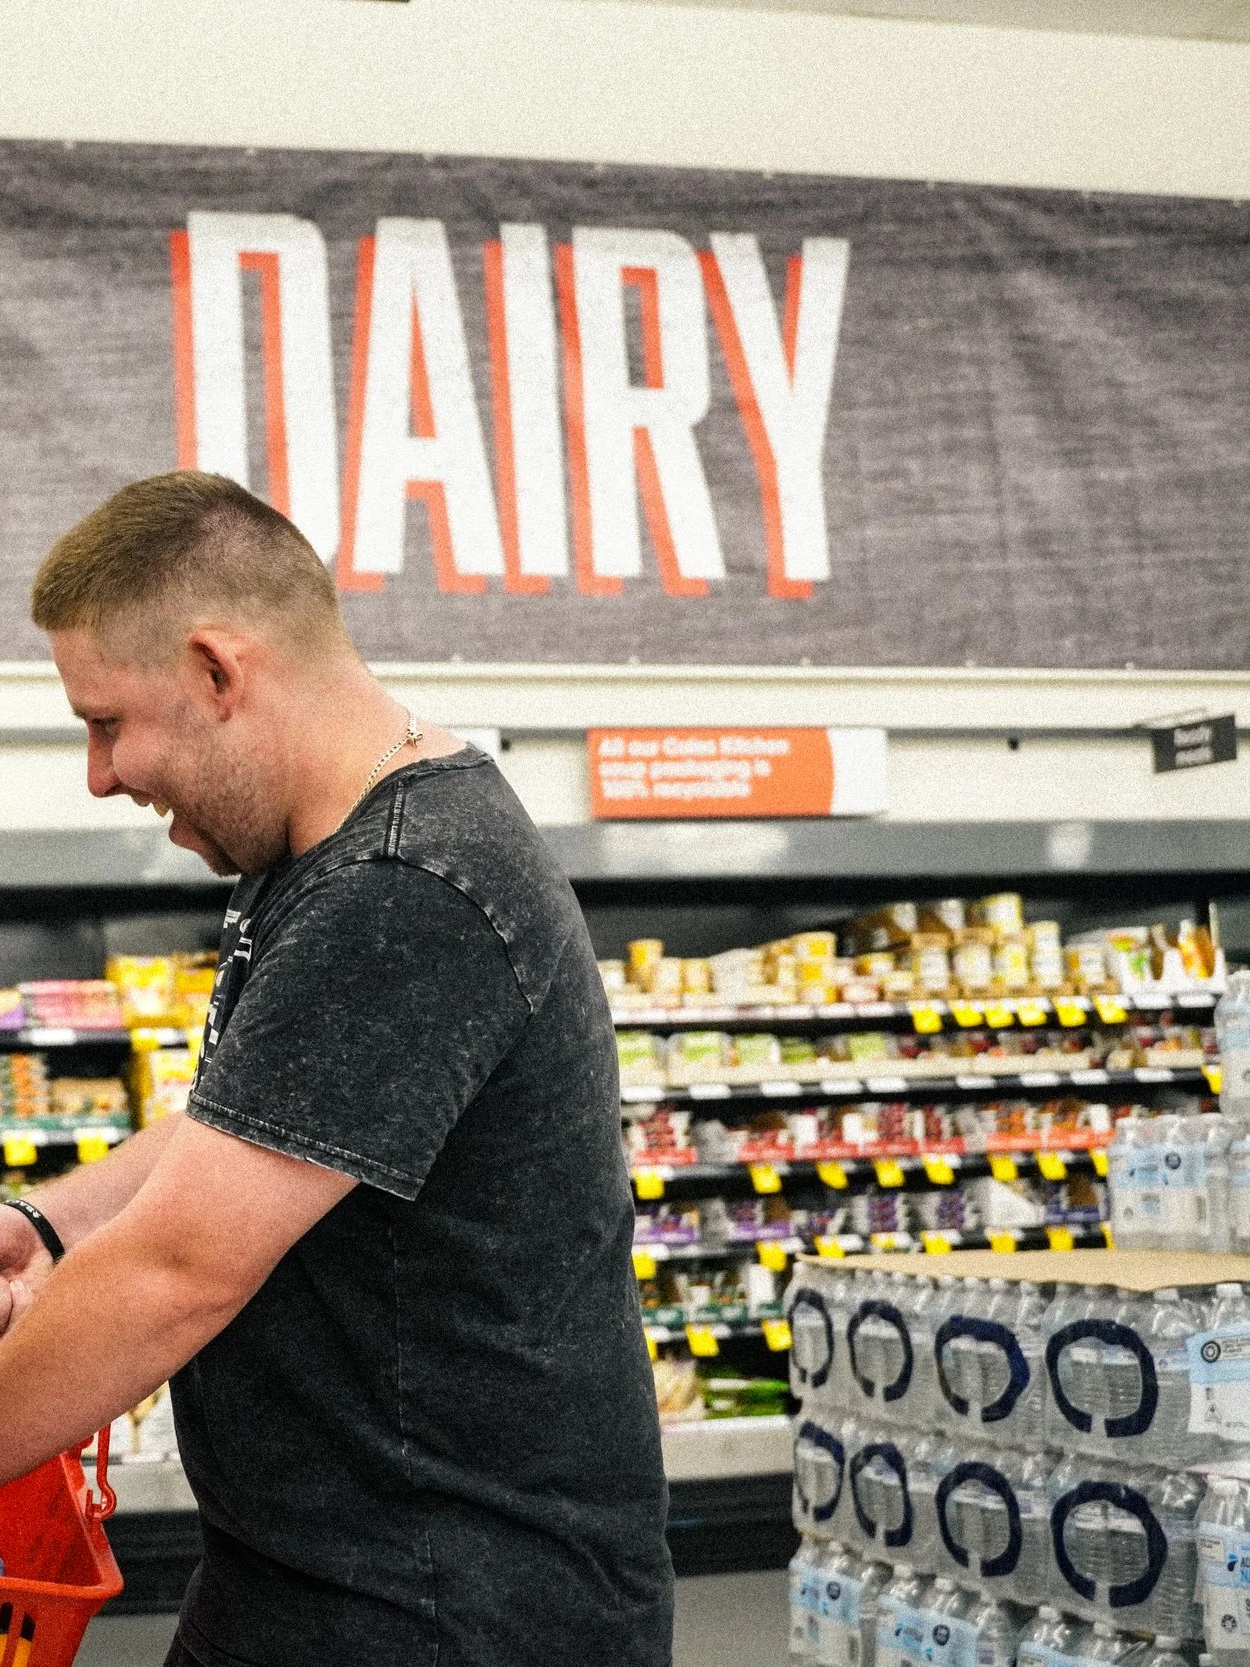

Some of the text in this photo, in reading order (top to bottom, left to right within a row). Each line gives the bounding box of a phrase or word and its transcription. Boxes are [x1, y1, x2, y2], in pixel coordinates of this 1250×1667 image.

[171, 211, 850, 598] DAIRY
[600, 737, 625, 757] All
[628, 740, 659, 757] our
